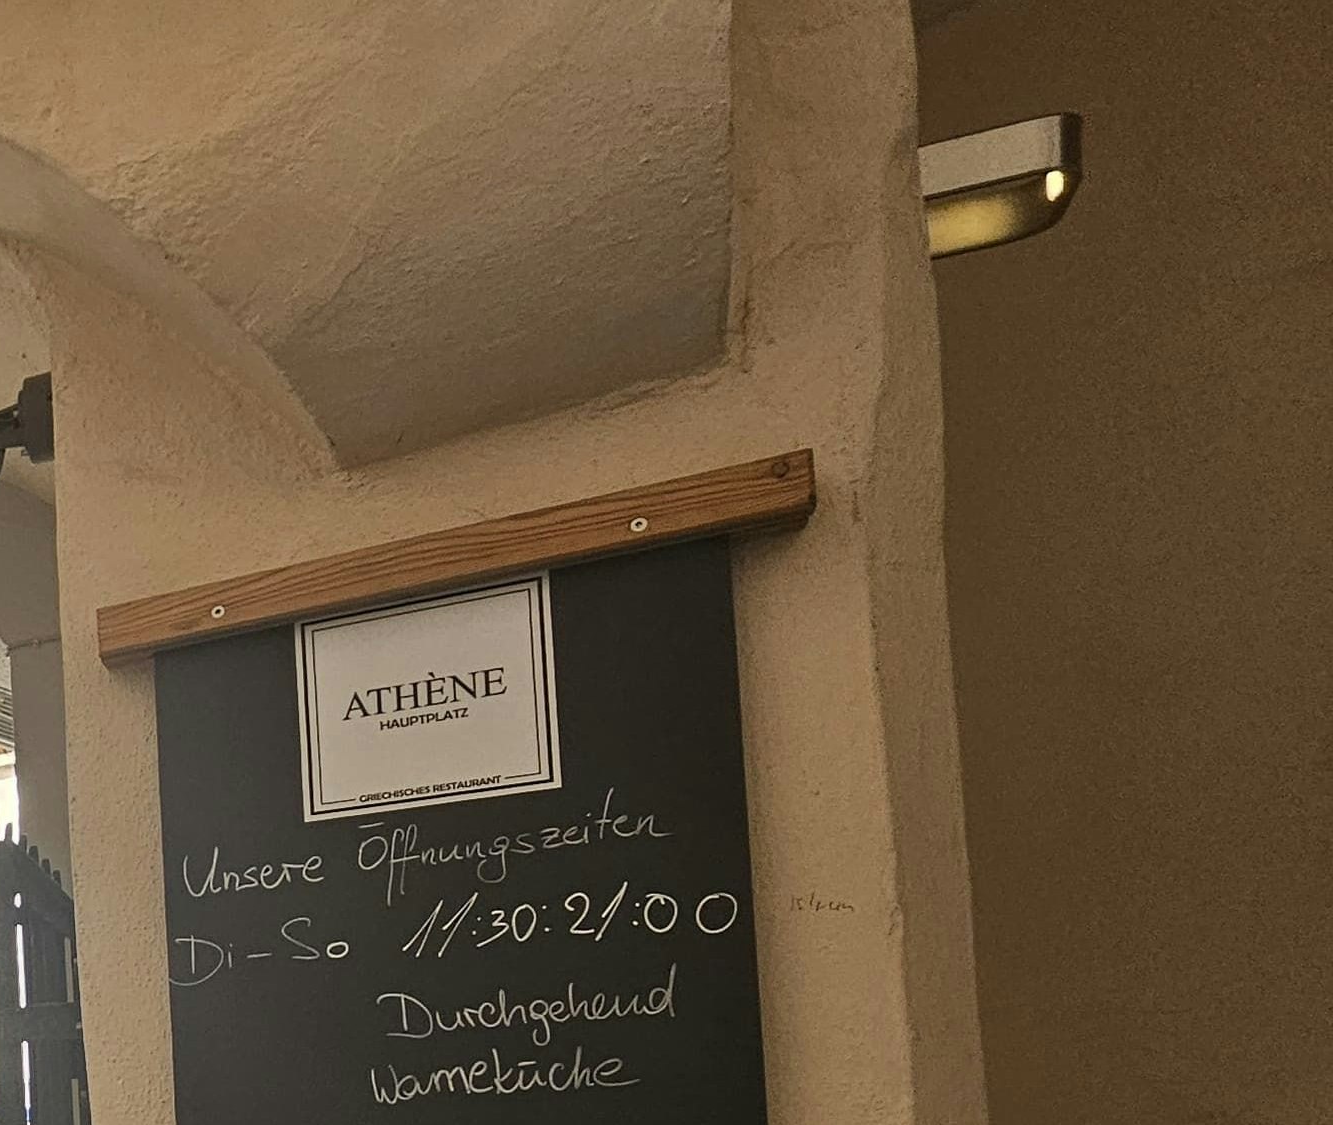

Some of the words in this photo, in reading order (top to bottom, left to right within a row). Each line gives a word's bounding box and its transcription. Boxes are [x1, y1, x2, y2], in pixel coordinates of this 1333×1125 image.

[342, 667, 508, 721] ATHÈNE
[380, 707, 469, 731] HAUPTPLATZ
[359, 785, 430, 803] GRIECHISCHES
[433, 775, 501, 793] RESTAURANT
[182, 847, 325, 898] Unsere
[358, 788, 675, 906] Öffnungszeiten
[377, 963, 677, 1046] Durchgehend
